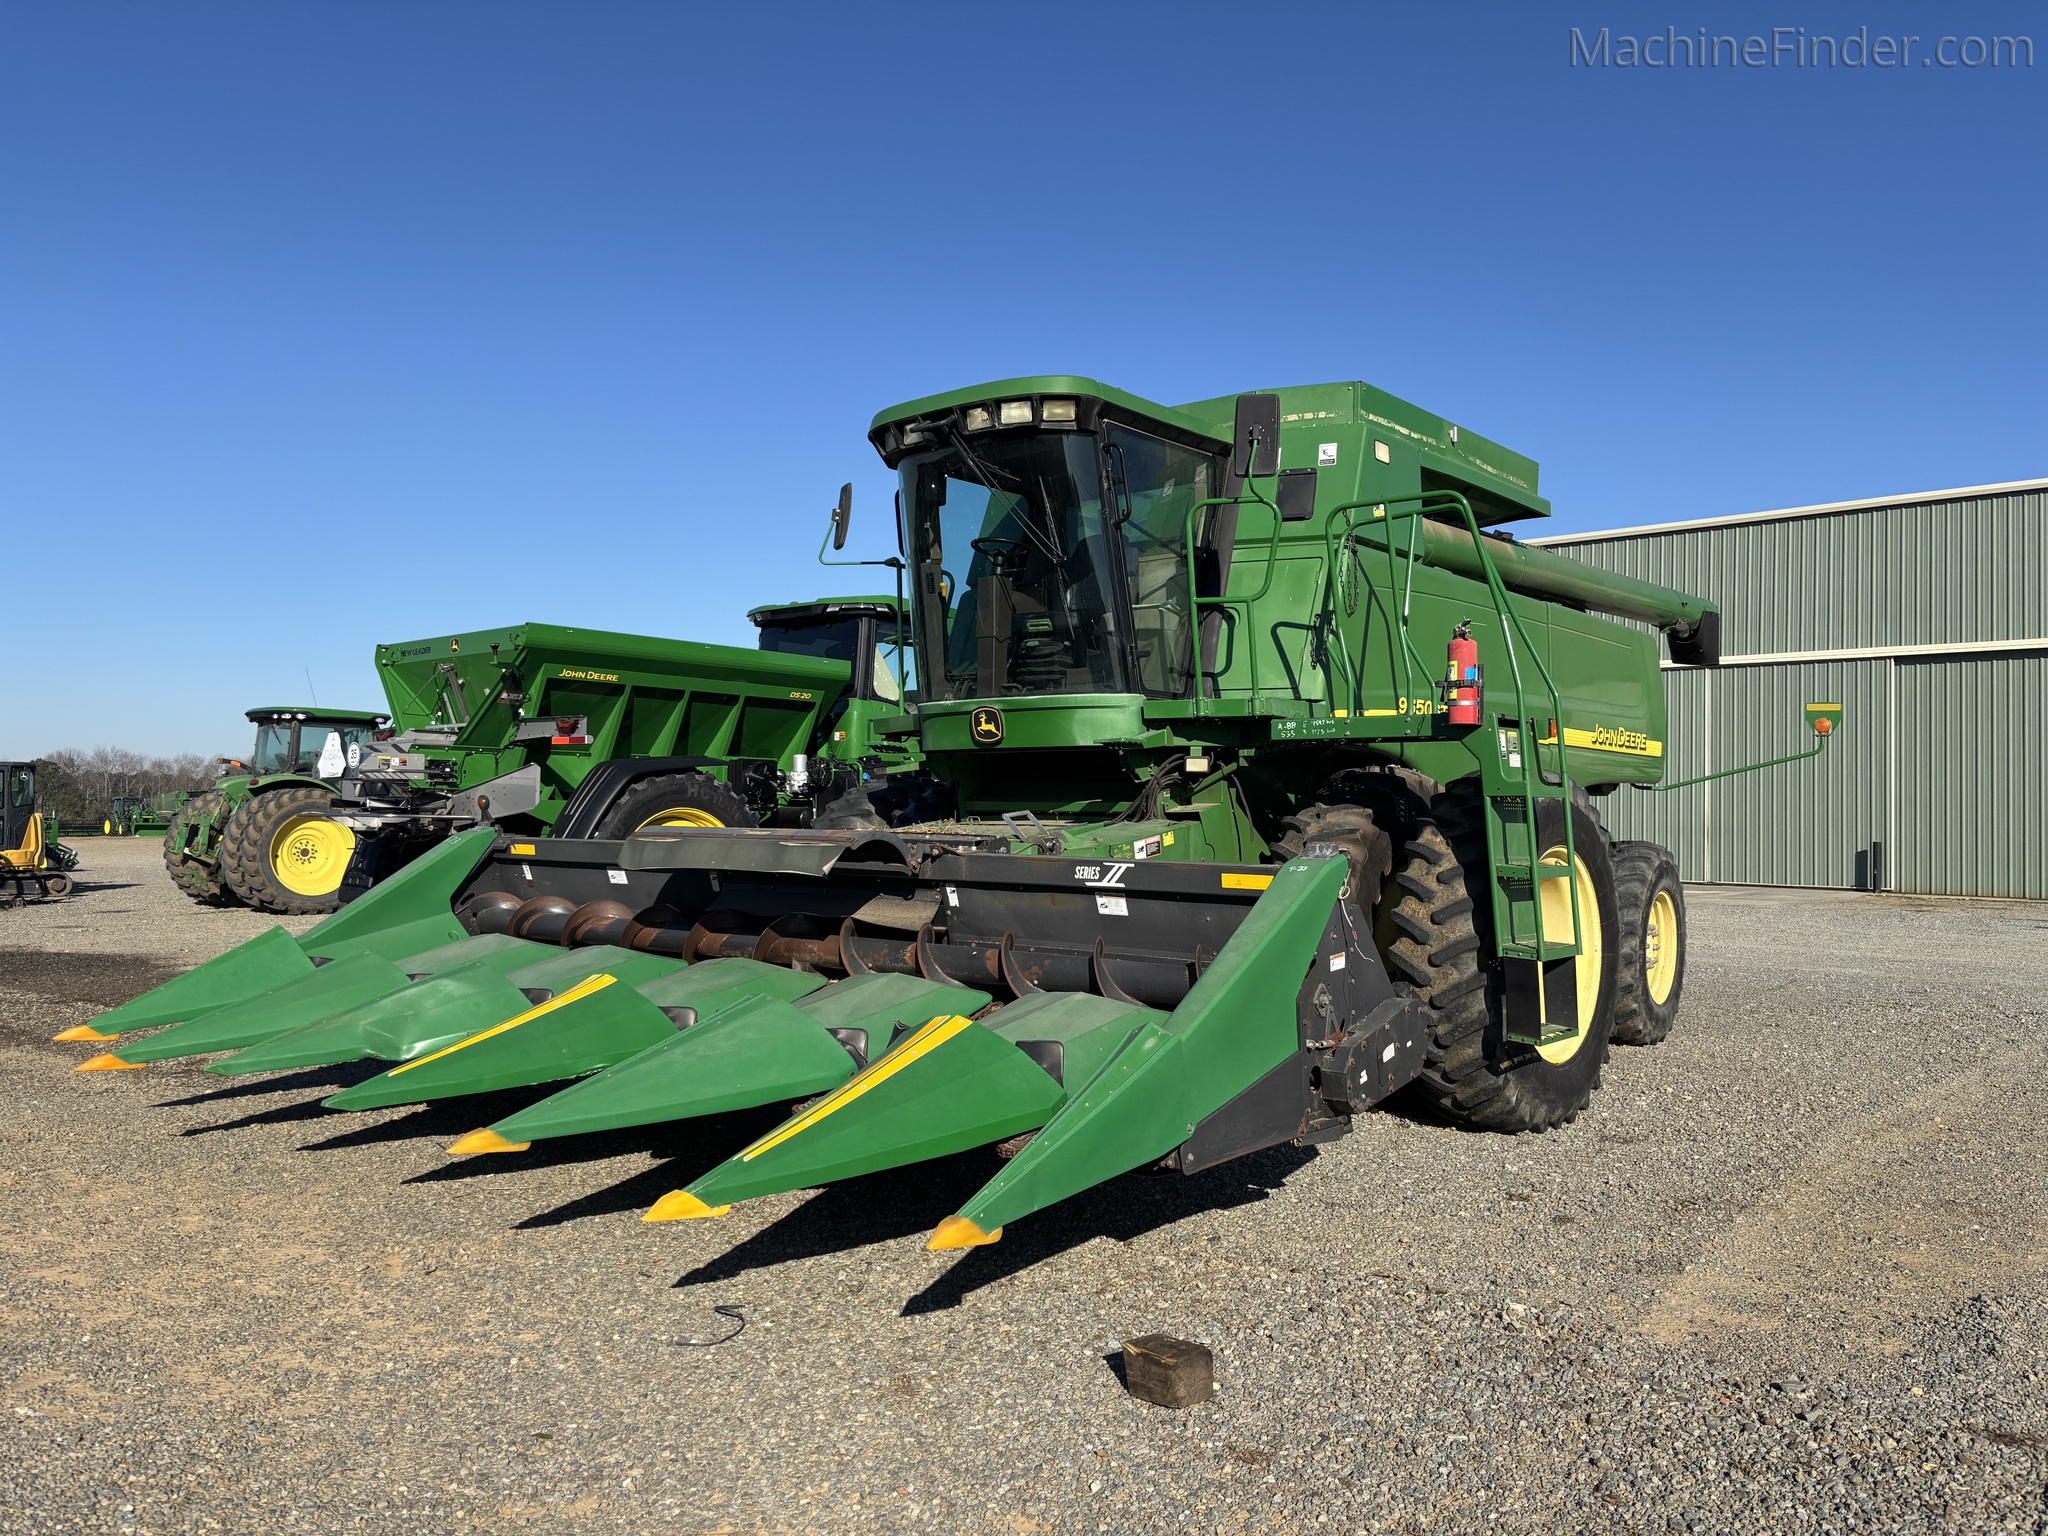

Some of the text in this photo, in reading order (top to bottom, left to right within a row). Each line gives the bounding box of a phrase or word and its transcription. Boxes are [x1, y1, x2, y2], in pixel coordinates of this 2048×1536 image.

[400, 646, 431, 657] NEW LEADER
[559, 669, 619, 682] JOHN DEERE
[1591, 722, 1648, 751] JOHN DEERE
[1074, 865, 1101, 880] SERIES
